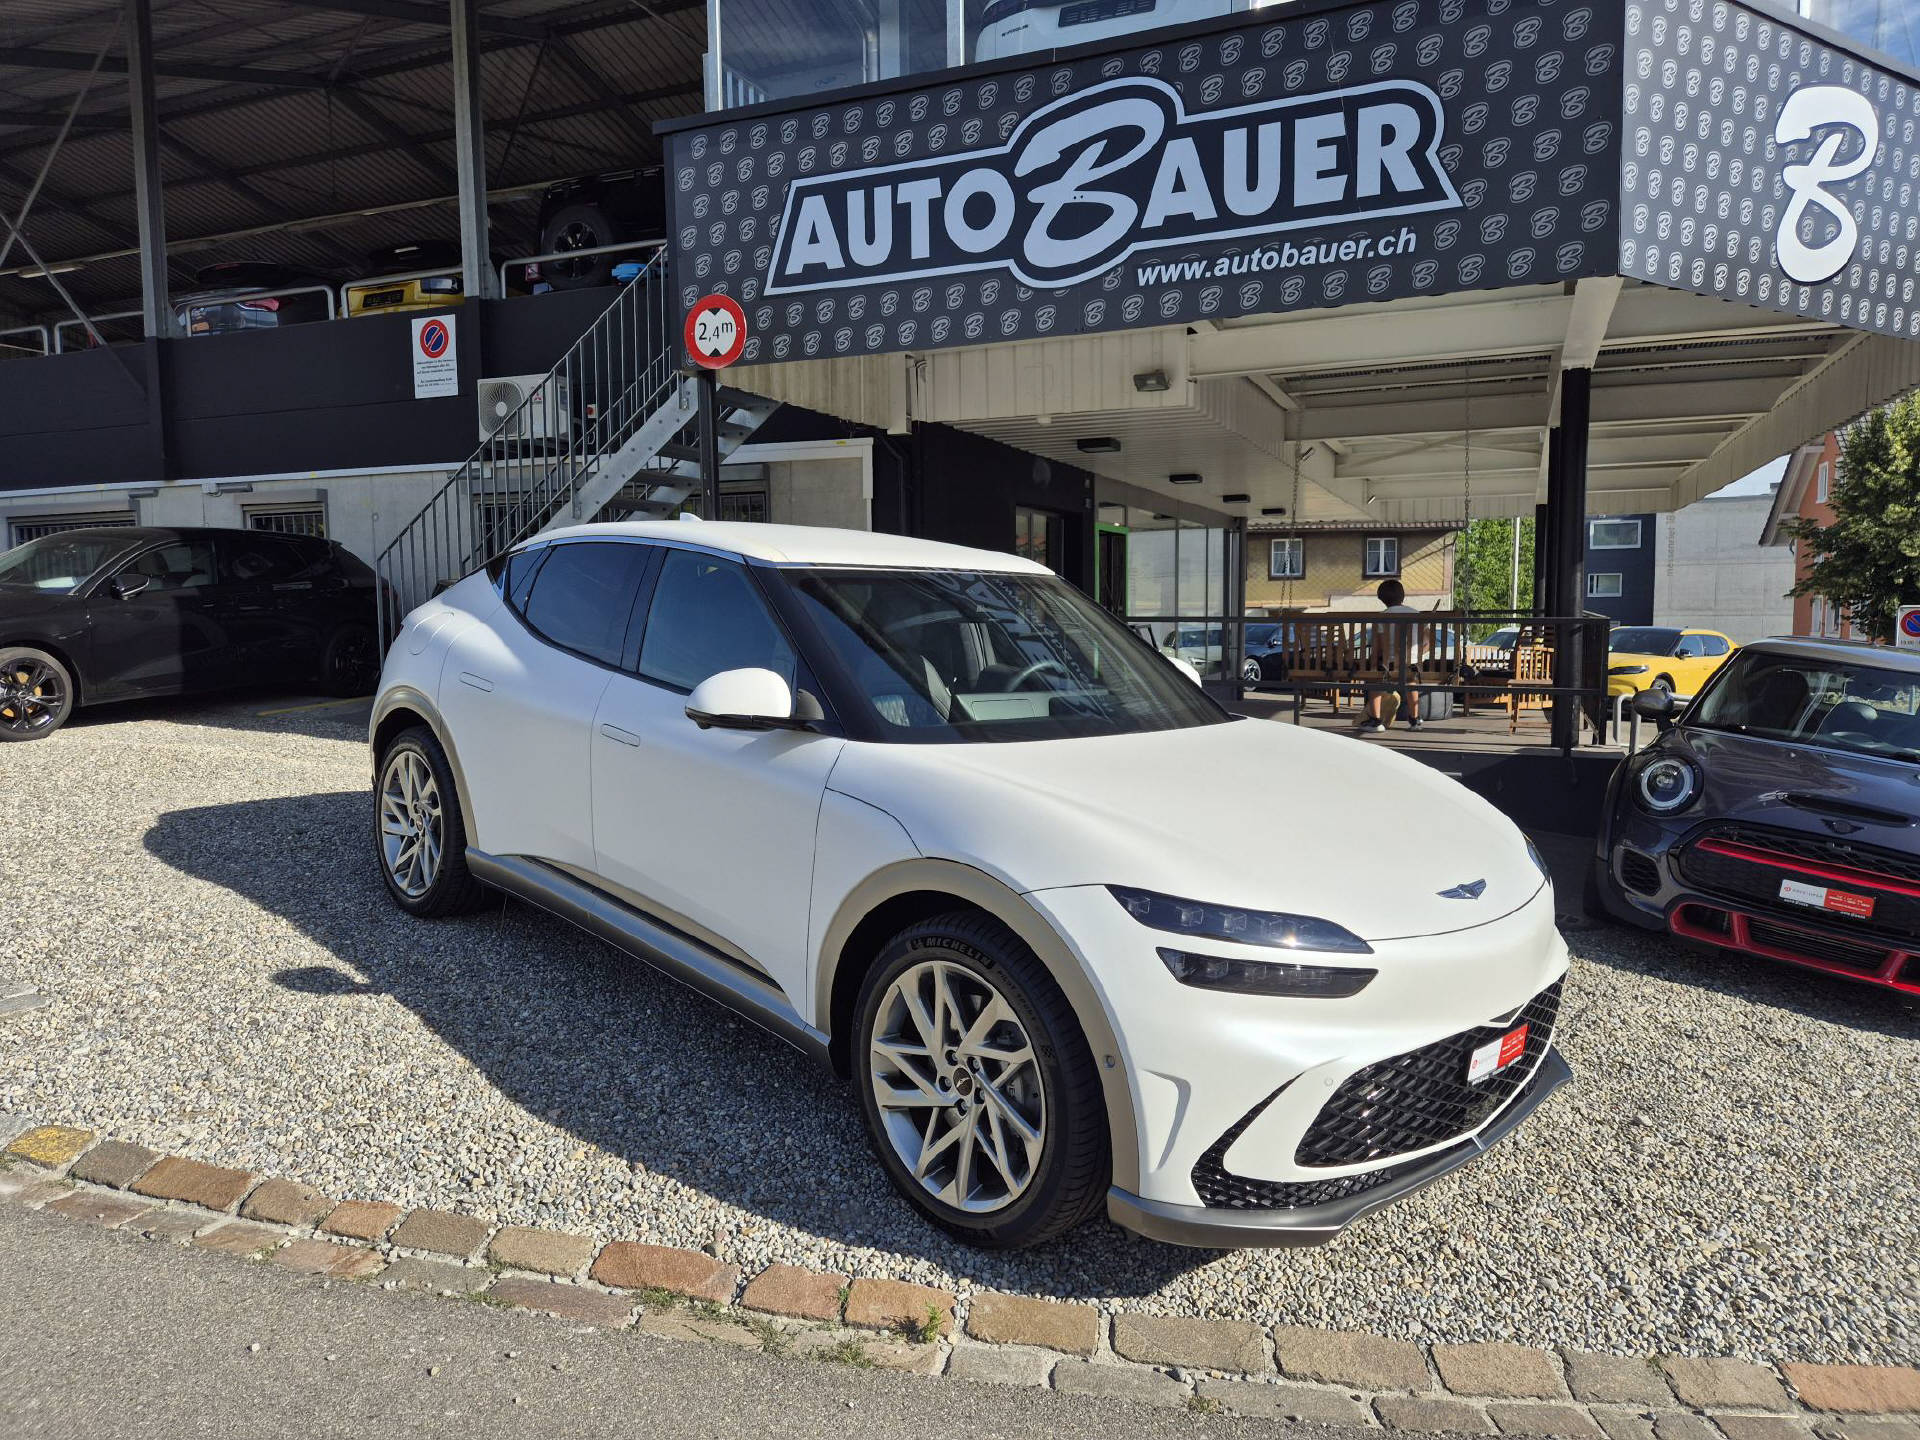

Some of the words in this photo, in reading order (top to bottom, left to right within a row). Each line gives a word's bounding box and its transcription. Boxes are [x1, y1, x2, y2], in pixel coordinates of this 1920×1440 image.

[785, 168, 1016, 275] AUTO
[1136, 227, 1417, 287] www.autobauer.ch
[926, 937, 993, 966] MICHELIN
